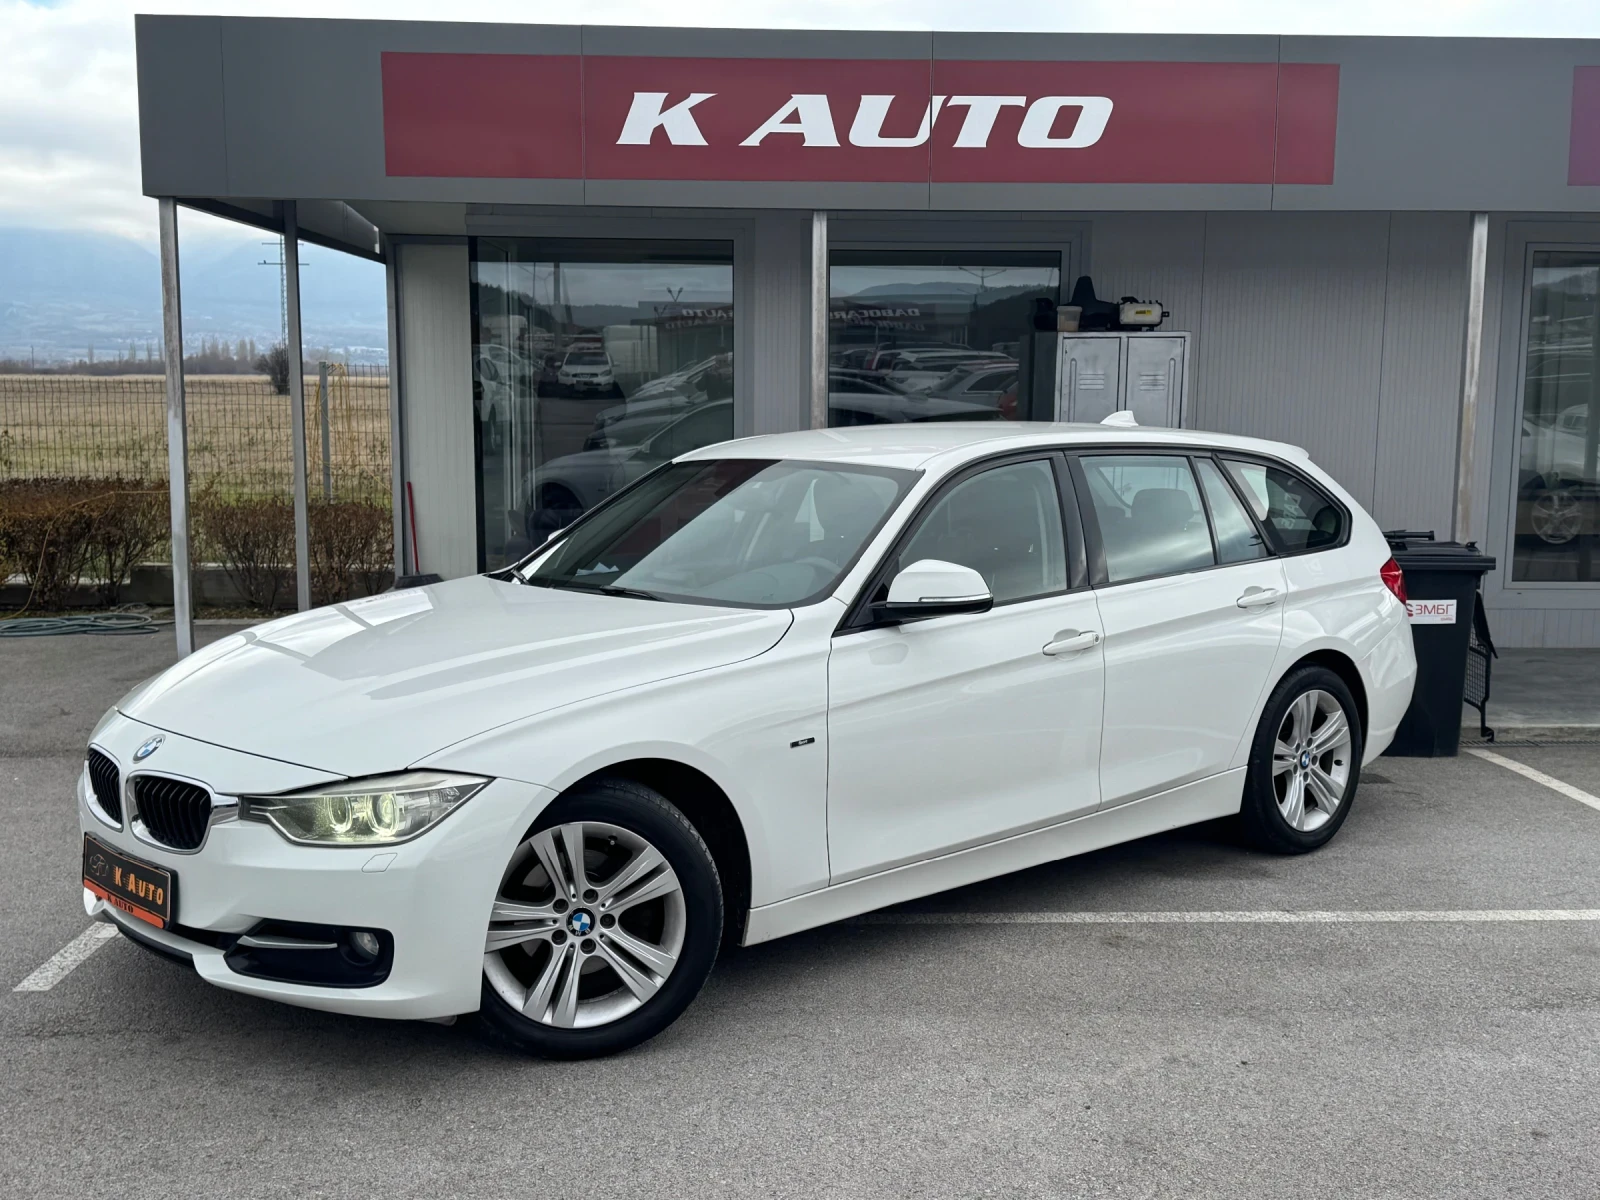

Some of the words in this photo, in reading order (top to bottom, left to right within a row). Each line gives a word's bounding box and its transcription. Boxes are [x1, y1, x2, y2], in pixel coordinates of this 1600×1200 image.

[616, 91, 719, 146] K
[738, 93, 1114, 149] AUTO
[113, 898, 134, 914] AUTO
[114, 866, 123, 887] K
[128, 873, 164, 906] AUTO
